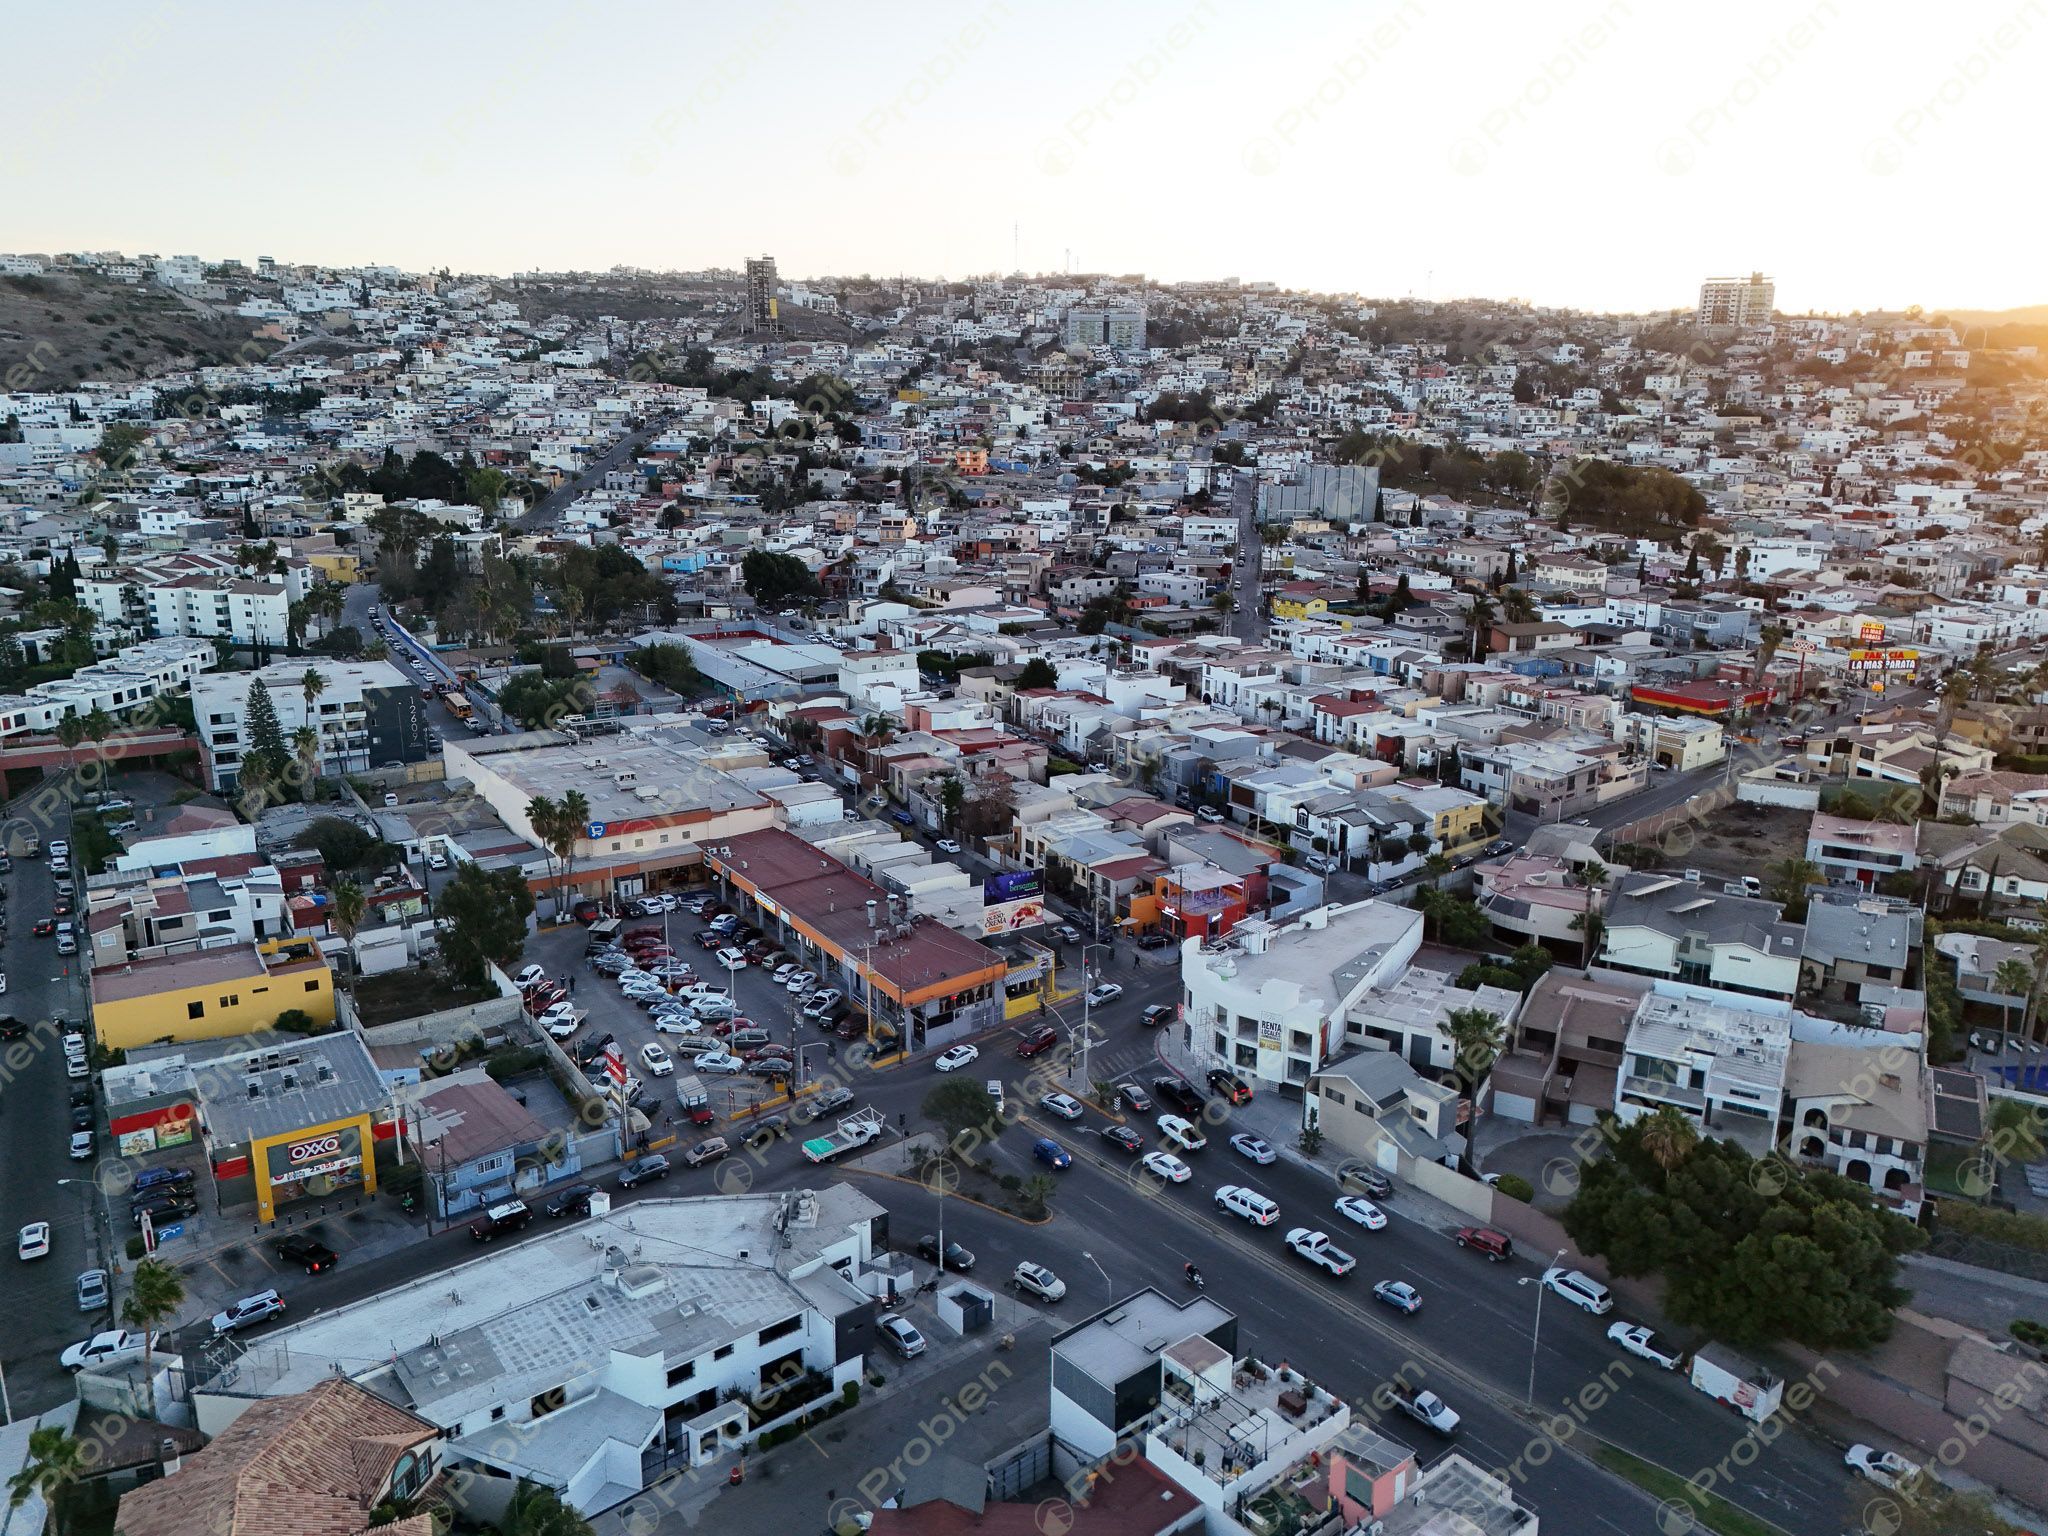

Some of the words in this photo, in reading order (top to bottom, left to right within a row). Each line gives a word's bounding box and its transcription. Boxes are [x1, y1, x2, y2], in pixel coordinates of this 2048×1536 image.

[1792, 640, 1815, 651] OXXO
[1852, 660, 1862, 670] LA
[1863, 660, 1883, 669] MAS
[409, 696, 418, 741] 12609
[1261, 1020, 1282, 1032] RENTA
[291, 1138, 338, 1160] OXXO
